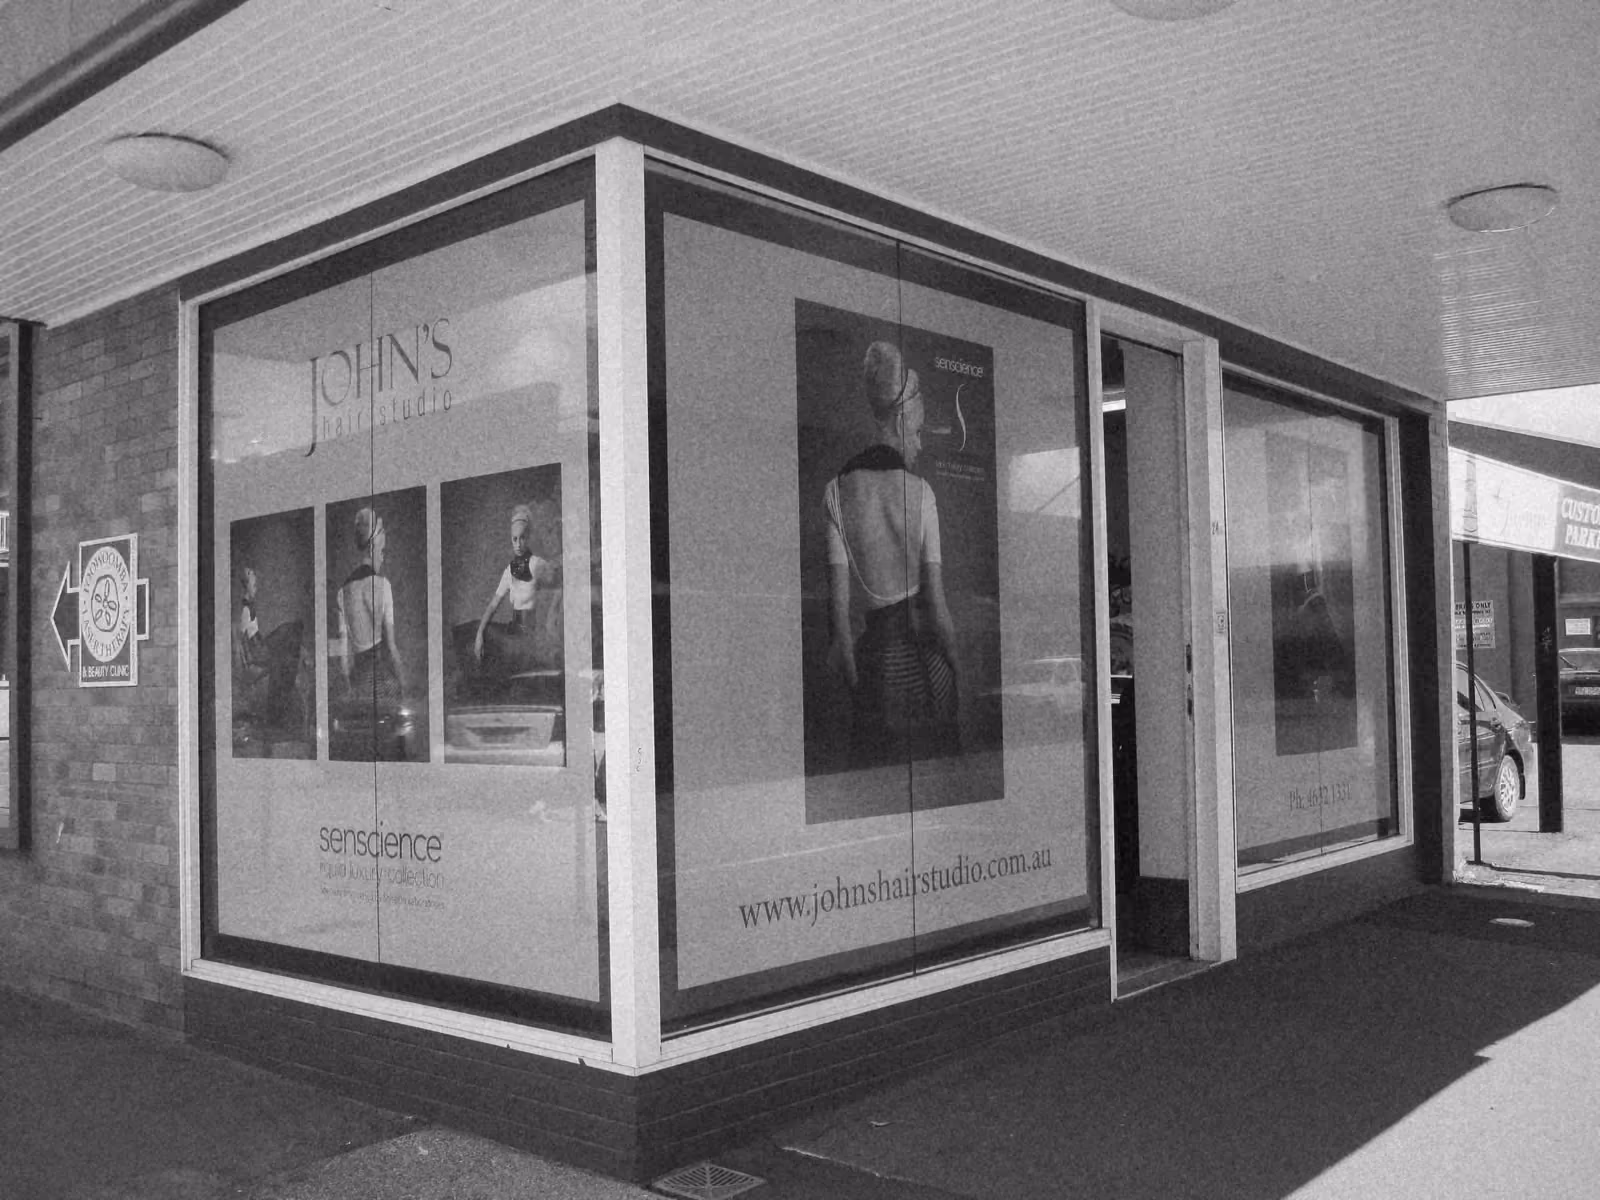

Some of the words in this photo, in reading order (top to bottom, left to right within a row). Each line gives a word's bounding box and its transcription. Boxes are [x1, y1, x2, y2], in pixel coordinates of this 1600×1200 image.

[935, 357, 984, 377] senscience
[304, 318, 452, 457] JOHN'S
[379, 387, 452, 426] studio
[88, 665, 109, 677] BEAUTY
[110, 664, 130, 676] CLINIC
[320, 820, 442, 862] senscience
[739, 848, 1052, 928] www.johnshairstudio.com.au
